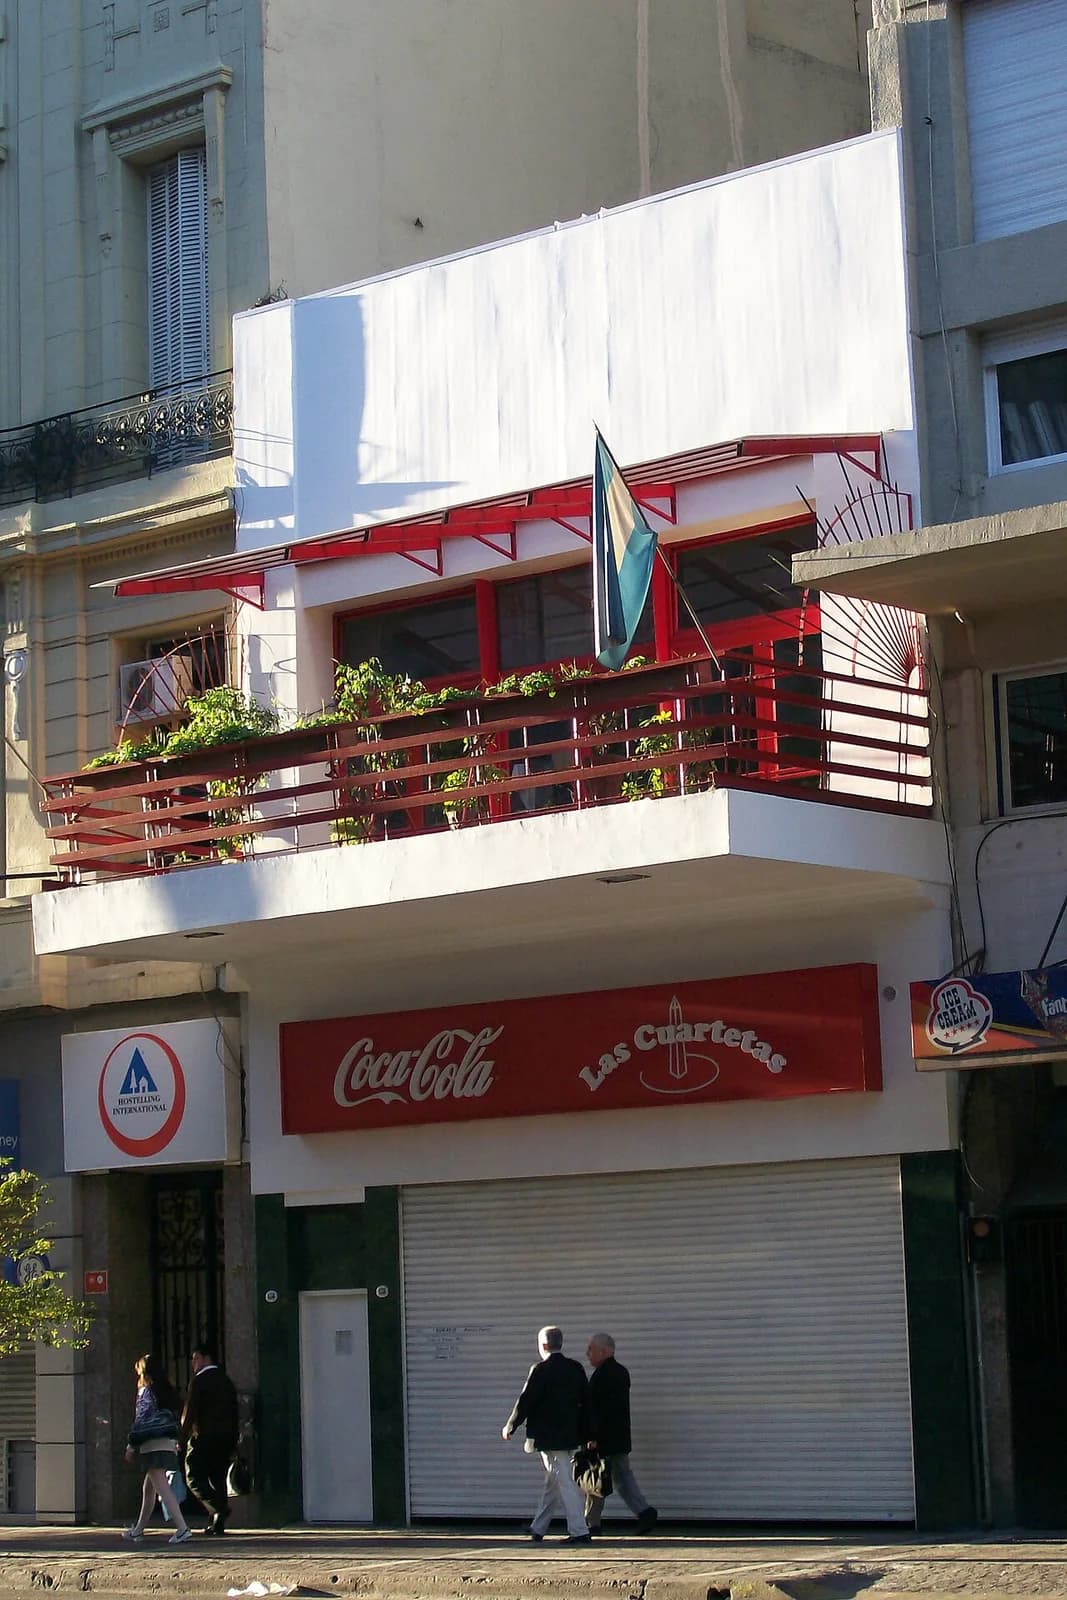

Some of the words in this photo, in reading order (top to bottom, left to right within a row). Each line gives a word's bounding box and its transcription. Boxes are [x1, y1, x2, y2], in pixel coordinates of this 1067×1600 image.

[941, 987, 961, 1010] ICE
[937, 1000, 977, 1031] CREAM
[578, 1042, 632, 1092] Las
[634, 1018, 788, 1075] Cuartetas
[112, 1104, 168, 1116] INTERNATIONAL
[118, 1095, 161, 1106] HOSTELLING
